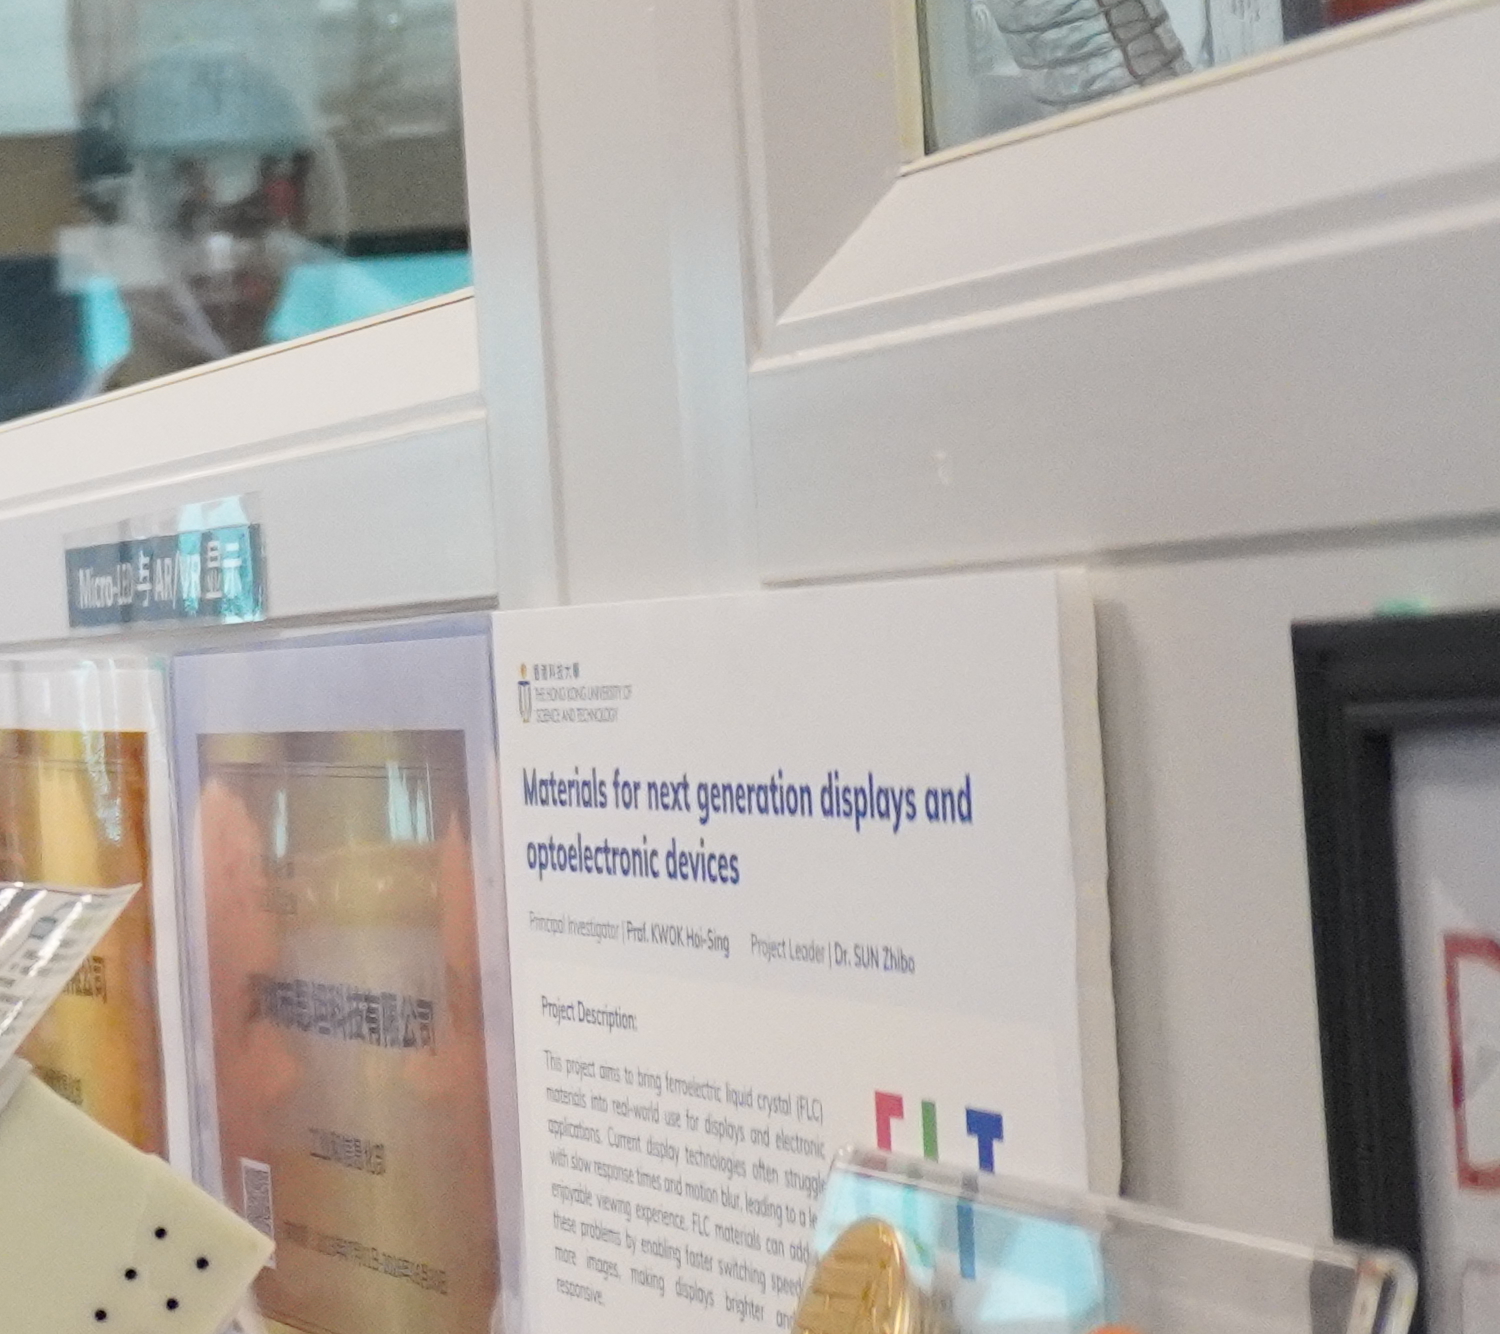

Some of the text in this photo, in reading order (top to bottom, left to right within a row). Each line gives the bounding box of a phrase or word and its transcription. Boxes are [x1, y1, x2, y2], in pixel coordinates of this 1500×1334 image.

[522, 767, 973, 834] Materials for next generation displays and
[526, 834, 740, 885] optoelectronic devices
[528, 911, 566, 942] Principal
[567, 916, 620, 946] Investigator
[650, 924, 684, 947] KWOK
[750, 933, 916, 975] Project Leader Dr. SUN Zhibo
[542, 995, 638, 1033] Project Description:
[544, 1050, 563, 1072] This
[566, 1056, 596, 1081] project
[599, 1063, 621, 1082] aims
[624, 1068, 635, 1085] to
[638, 1070, 662, 1096] bring
[726, 1082, 753, 1110] liquid
[757, 1091, 792, 1116] crystal
[796, 1094, 823, 1126] (FLC)
[546, 1086, 825, 1159] materials into real-world use for displays and electronic
[547, 1118, 603, 1146] applications.
[607, 1123, 641, 1152] Current
[646, 1134, 680, 1164] display
[685, 1145, 747, 1179] technologies
[752, 1159, 778, 1185] often
[549, 1148, 569, 1169] with
[571, 1152, 591, 1174] slow
[594, 1161, 634, 1184] response
[637, 1166, 662, 1191] times
[664, 1173, 682, 1196] and
[685, 1177, 718, 1207] motion
[745, 1191, 782, 1224] leading
[786, 1201, 797, 1223] to
[551, 1181, 593, 1209] enjoyable
[596, 1195, 631, 1220] viewing
[692, 1211, 710, 1238] FLC
[715, 1220, 761, 1253] materials
[765, 1236, 785, 1258] can
[552, 1211, 577, 1235] these
[581, 1216, 621, 1247] problems
[625, 1229, 637, 1255] by
[641, 1235, 681, 1268] enabling
[685, 1243, 713, 1274] faster
[717, 1254, 766, 1293] switching
[555, 1244, 577, 1267] more
[630, 1263, 665, 1296] making
[674, 1277, 715, 1307] displays
[725, 1289, 765, 1323] brighter
